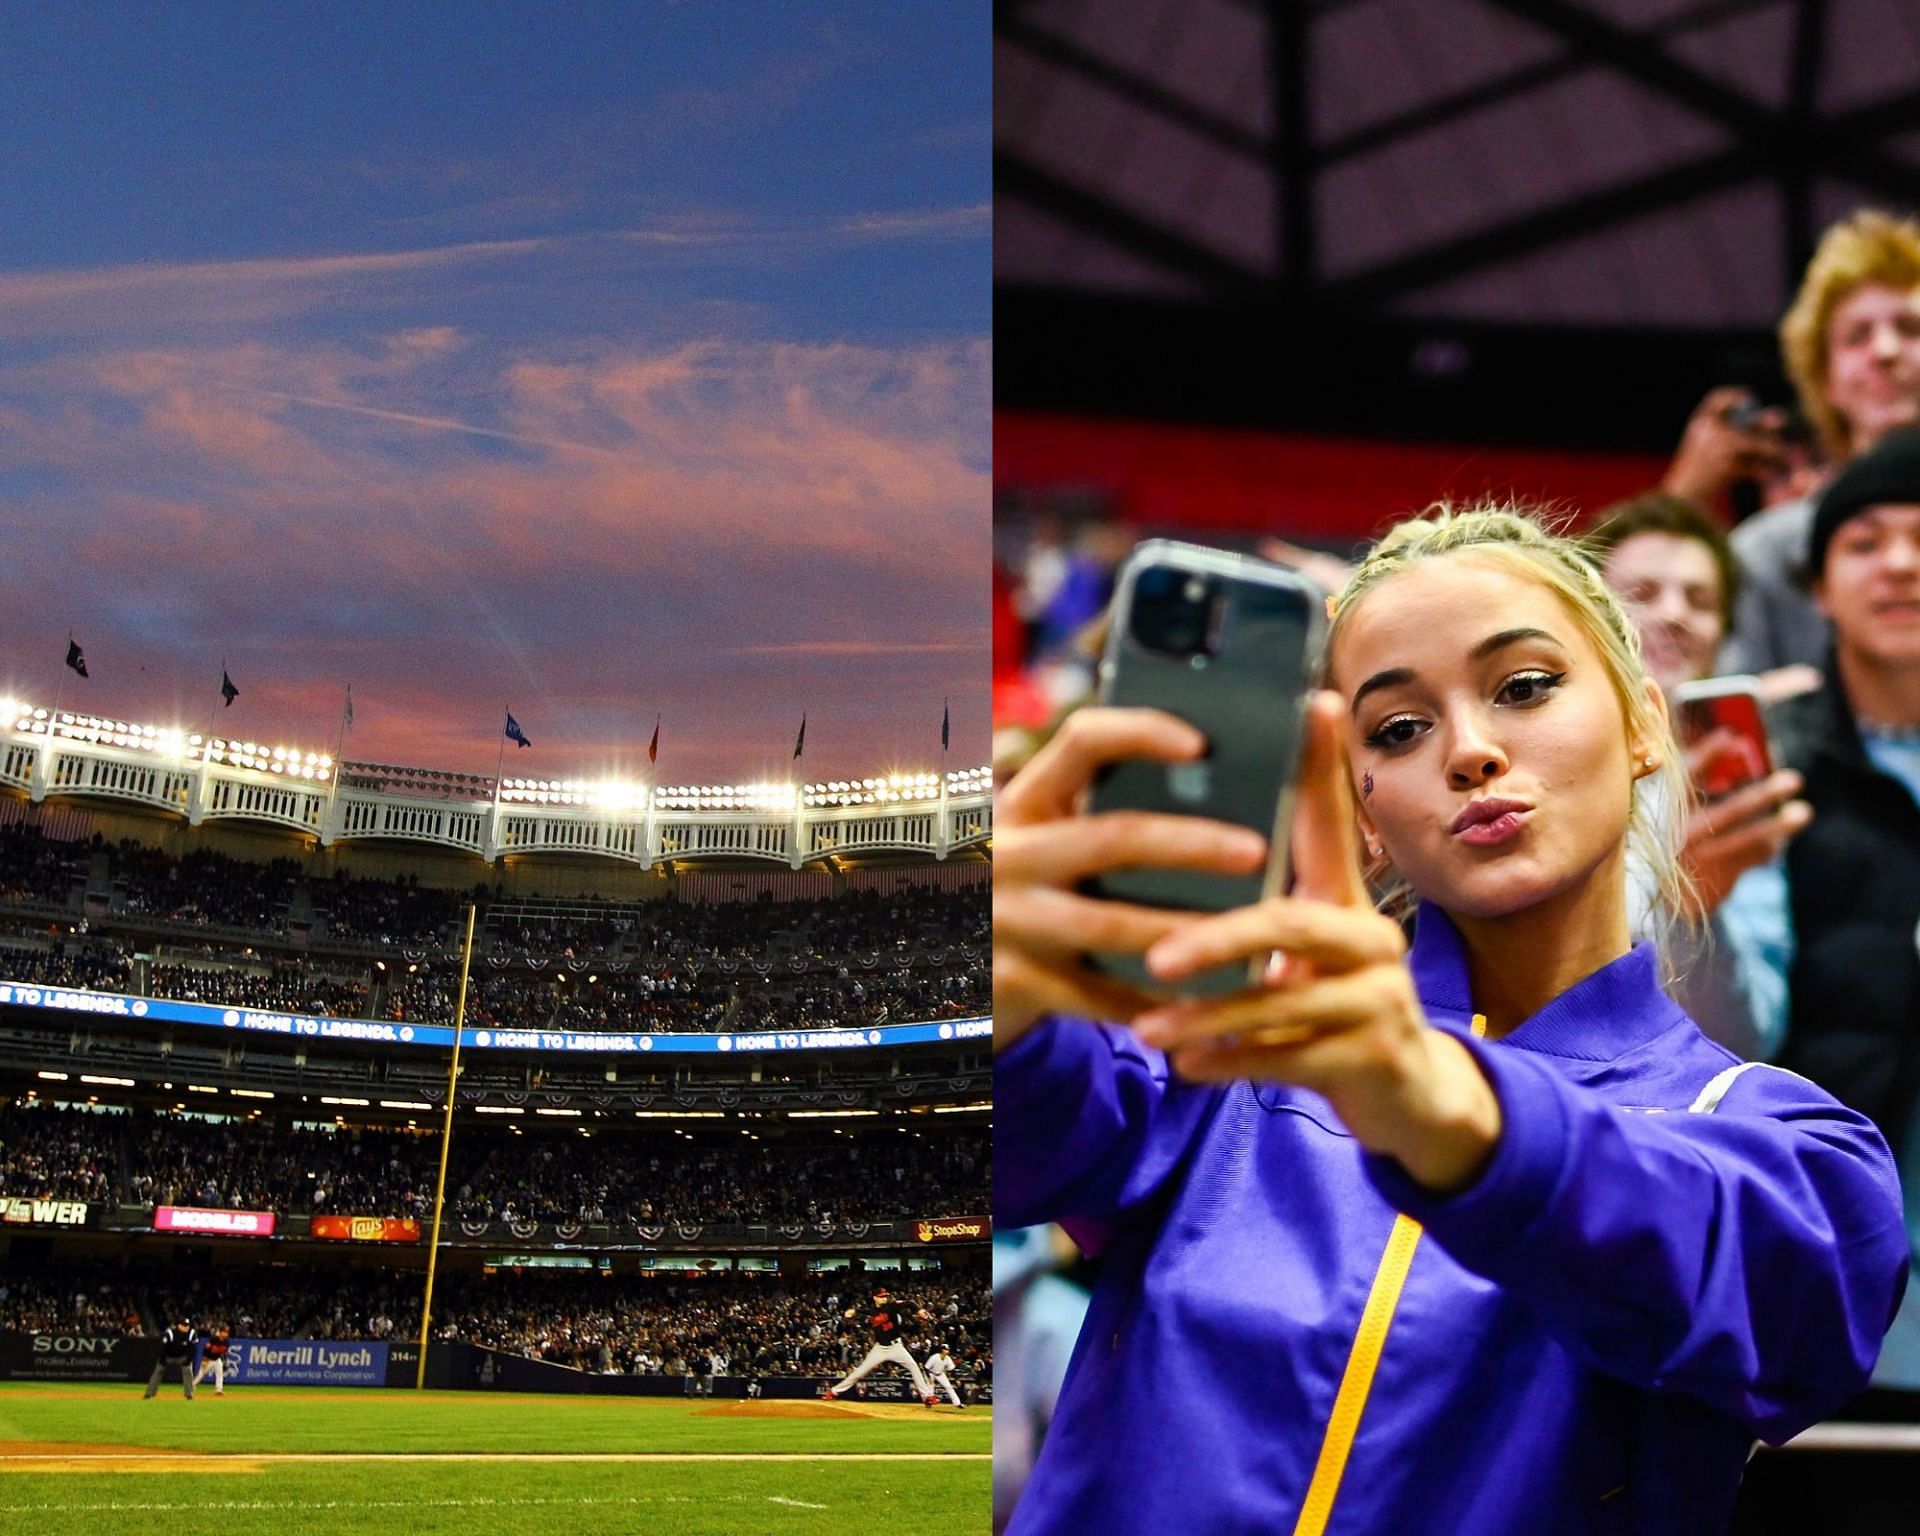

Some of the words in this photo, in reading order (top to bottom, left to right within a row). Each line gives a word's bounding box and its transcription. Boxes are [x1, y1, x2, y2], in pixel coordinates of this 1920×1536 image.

[16, 988, 41, 1005] TO
[244, 1013, 292, 1032] HOME
[295, 1017, 318, 1034] TO
[495, 1032, 539, 1047] HOME
[542, 1034, 563, 1049] TO
[735, 1034, 776, 1050] HOME
[778, 1033, 798, 1048] TO
[33, 1336, 119, 1352] SONY
[249, 1346, 312, 1365] Merrill
[318, 1347, 371, 1368] Lynch
[247, 1368, 270, 1377] Bank
[273, 1368, 284, 1378] of
[285, 1369, 321, 1380] America
[324, 1370, 375, 1381] Corporation
